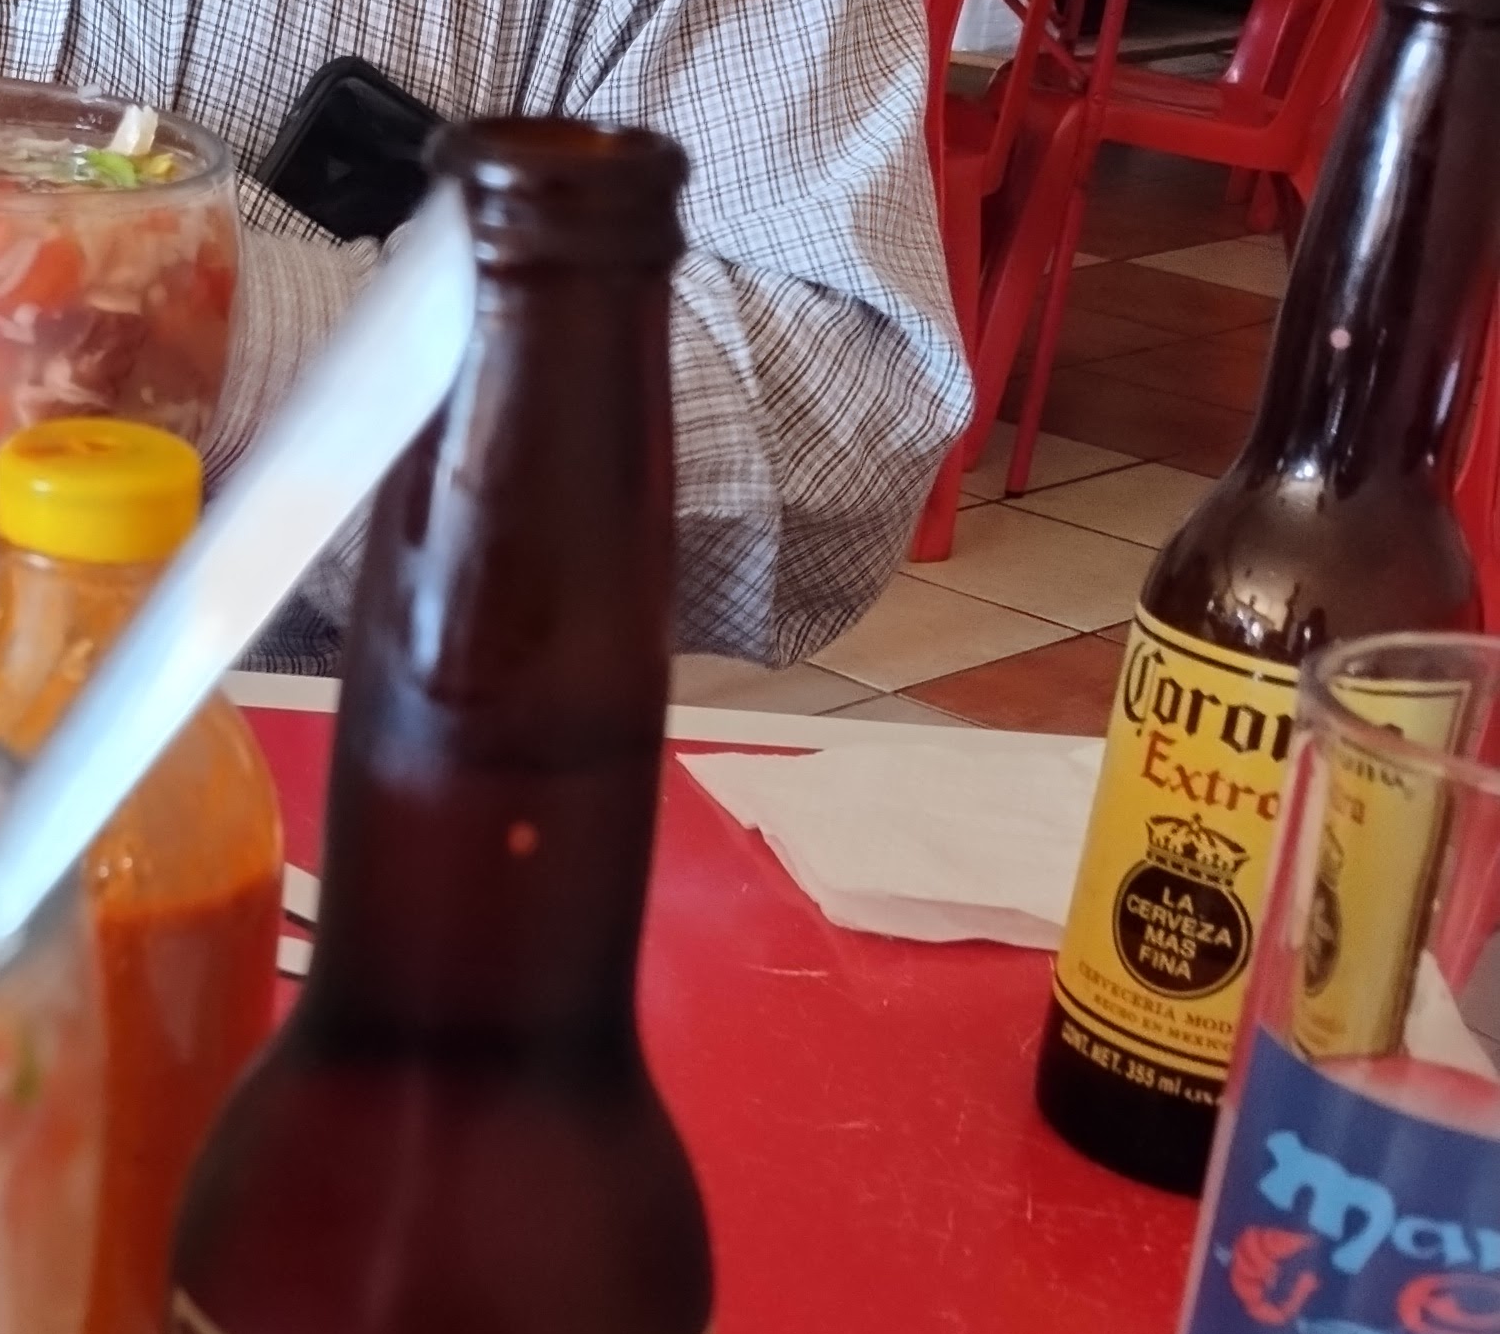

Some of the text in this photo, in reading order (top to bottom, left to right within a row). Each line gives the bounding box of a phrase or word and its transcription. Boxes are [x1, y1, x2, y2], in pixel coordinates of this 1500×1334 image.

[1162, 886, 1194, 915] LA
[1126, 893, 1232, 948] CERVEZA
[1144, 924, 1197, 959] MAS
[1139, 944, 1191, 981] FINA
[1185, 1011, 1234, 1034] MOD
[1126, 1059, 1155, 1088] 355
